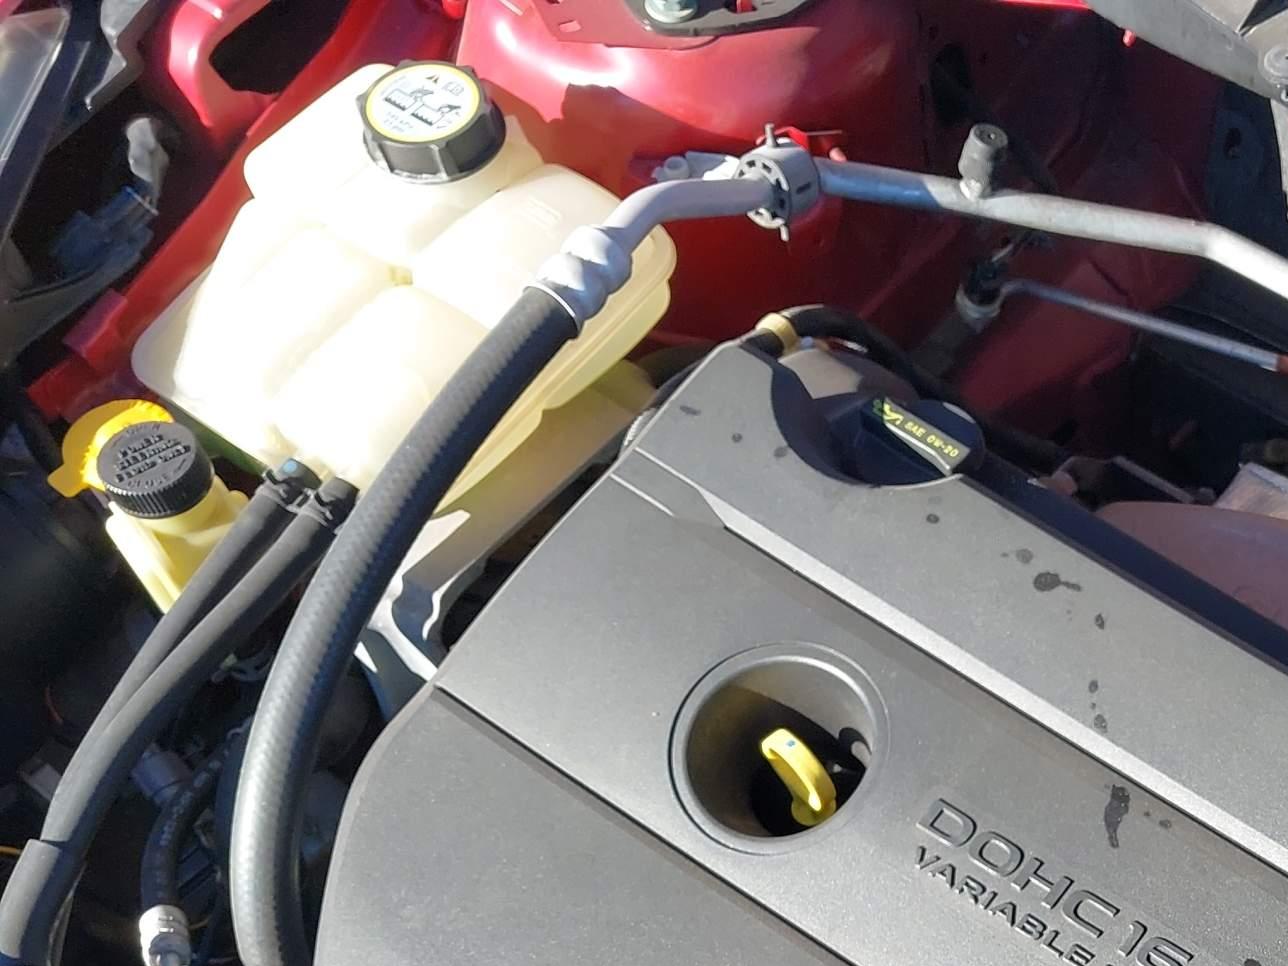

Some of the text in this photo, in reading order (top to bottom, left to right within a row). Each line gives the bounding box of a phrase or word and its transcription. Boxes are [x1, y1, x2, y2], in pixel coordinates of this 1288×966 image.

[905, 421, 959, 457] SAE 0W-20
[915, 797, 1121, 941] DOHC
